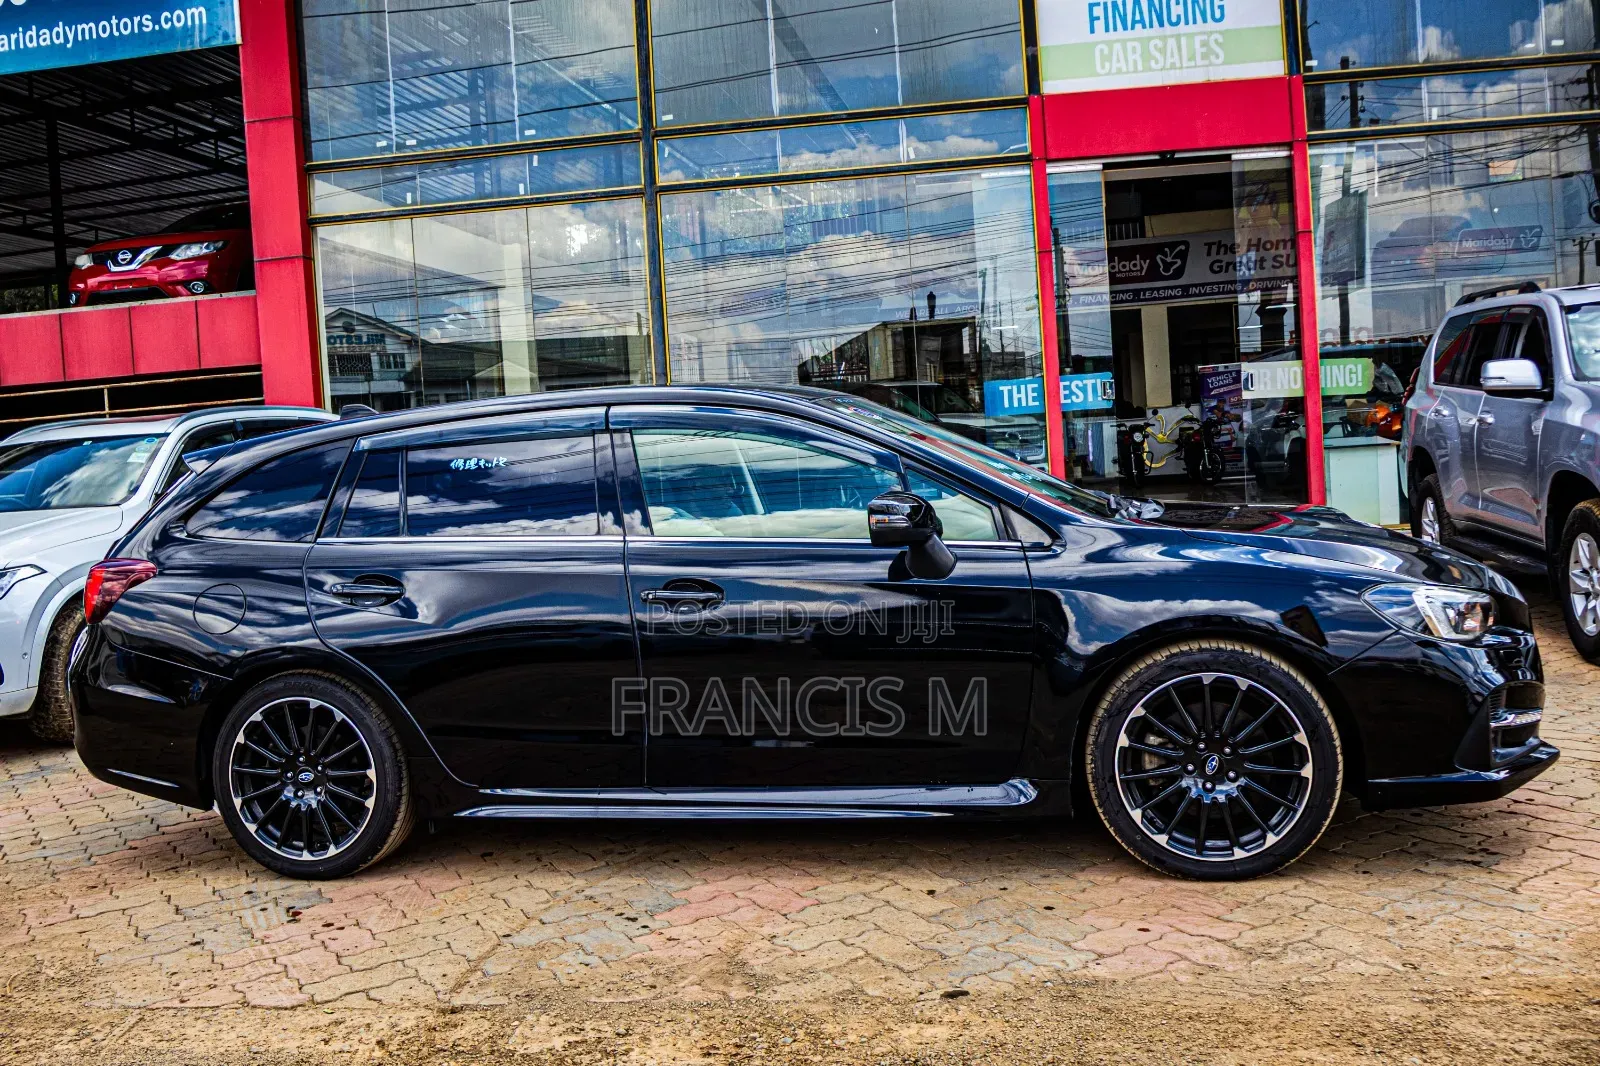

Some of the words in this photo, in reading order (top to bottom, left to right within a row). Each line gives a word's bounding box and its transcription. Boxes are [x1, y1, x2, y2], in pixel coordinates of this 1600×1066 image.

[1088, 0, 1225, 34] FINANCING
[0, 6, 207, 52] aridadymotors.com
[1095, 40, 1143, 75] CAR
[1149, 33, 1224, 70] SALES
[1204, 240, 1241, 257] The
[1209, 255, 1267, 274] Great
[1079, 292, 1133, 304] FINANCING
[1140, 287, 1182, 300] LEASING
[1189, 283, 1242, 295] INVESTING
[1206, 371, 1237, 383] VEHICLE
[1209, 377, 1234, 389] LOANS
[999, 383, 1040, 408] THE
[1060, 378, 1103, 404] EST!
